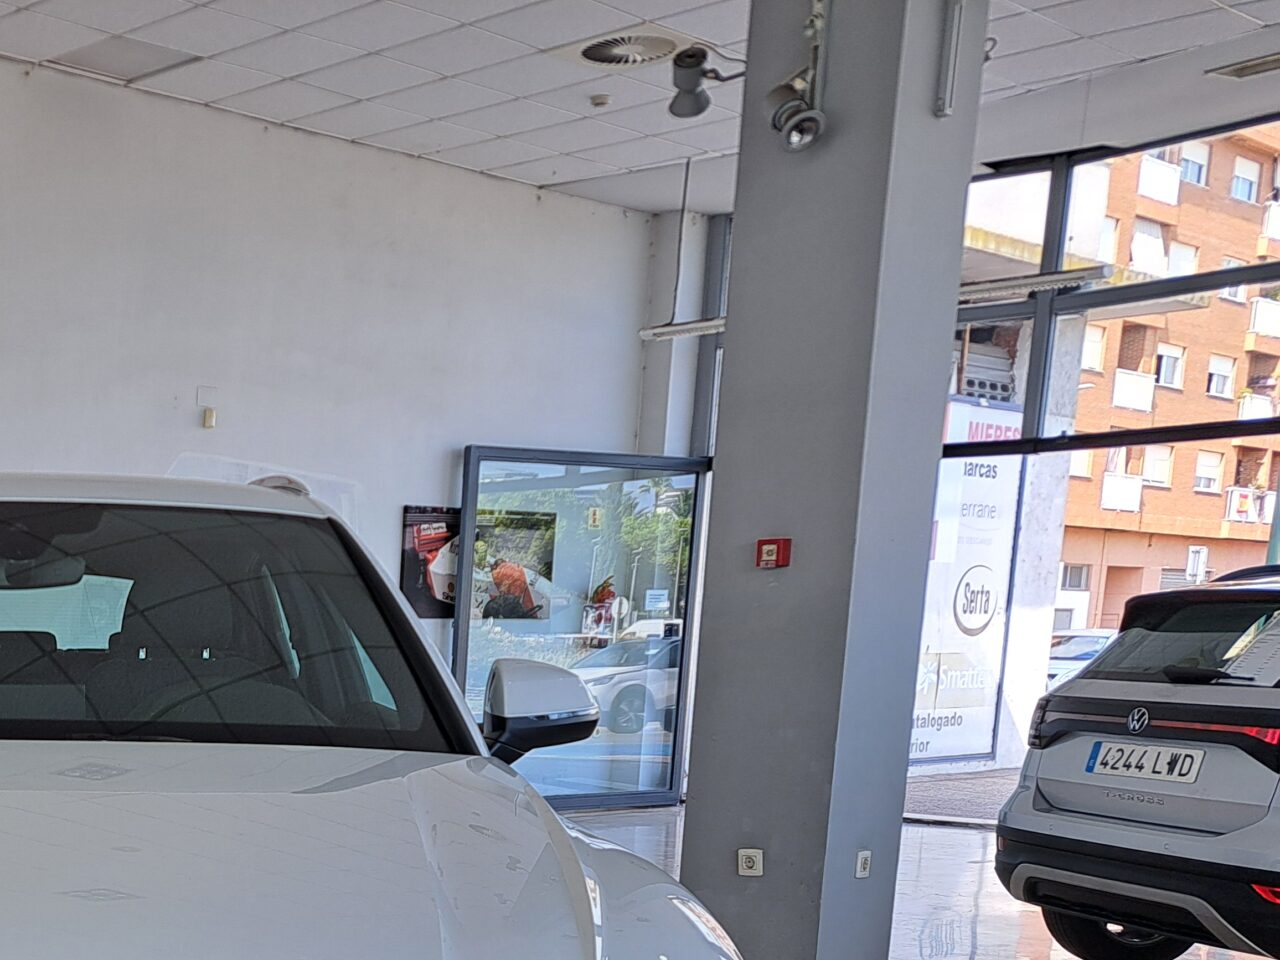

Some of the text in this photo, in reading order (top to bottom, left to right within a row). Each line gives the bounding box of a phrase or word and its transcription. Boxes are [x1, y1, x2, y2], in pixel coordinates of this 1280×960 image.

[962, 581, 991, 615] Serta
[913, 711, 963, 732] talogado
[1099, 746, 1148, 773] 4244
